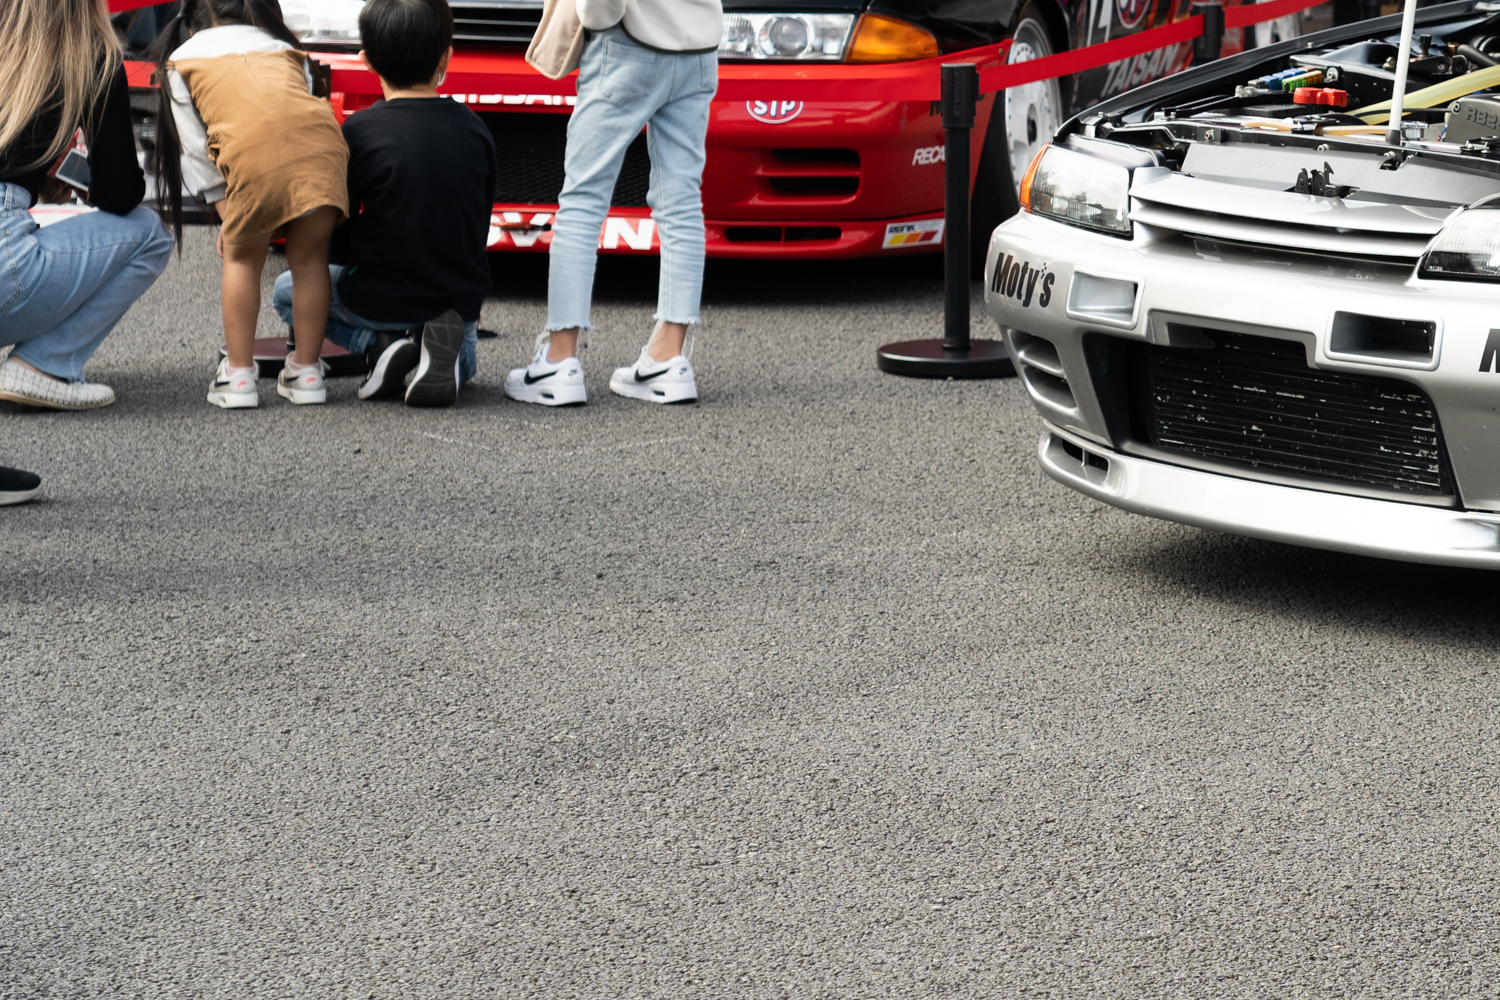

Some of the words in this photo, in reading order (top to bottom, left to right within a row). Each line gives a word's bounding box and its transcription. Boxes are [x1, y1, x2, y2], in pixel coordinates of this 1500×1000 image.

[1100, 42, 1181, 97] TAISAN
[912, 145, 946, 166] RECA
[990, 251, 1056, 308] Moty's
